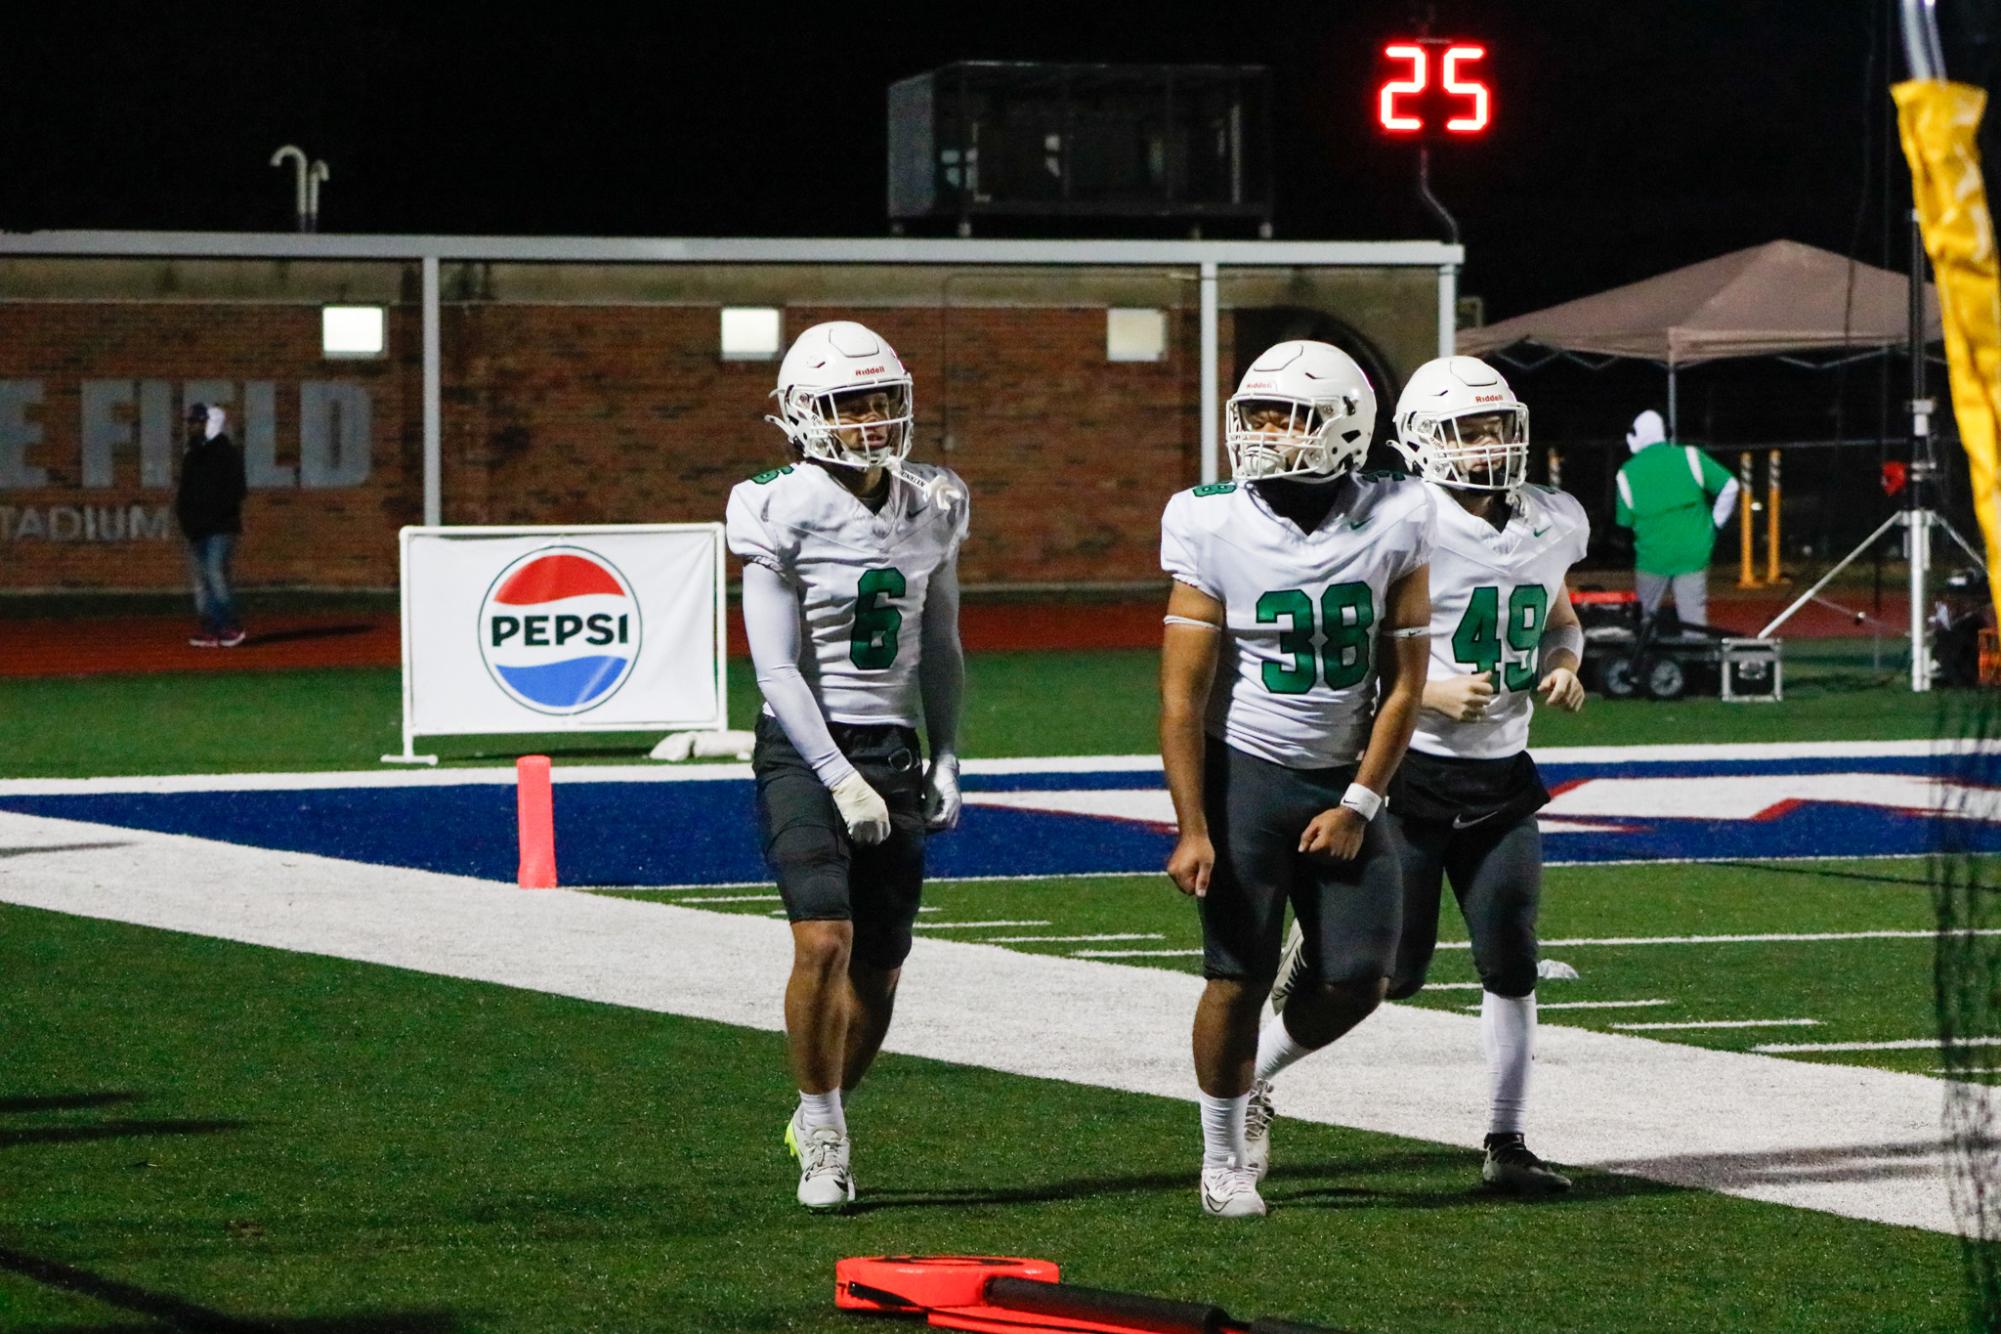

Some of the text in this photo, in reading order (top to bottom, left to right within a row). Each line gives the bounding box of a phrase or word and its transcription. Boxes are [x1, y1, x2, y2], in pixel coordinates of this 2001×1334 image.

[1379, 45, 1489, 131] 25
[855, 365, 885, 377] Riddell
[1474, 394, 1504, 403] Riddell
[81, 379, 373, 489] FILD
[491, 613, 629, 647] PEPSI
[849, 566, 907, 671] 6
[1256, 580, 1374, 695] 38
[1451, 584, 1549, 694] 49
